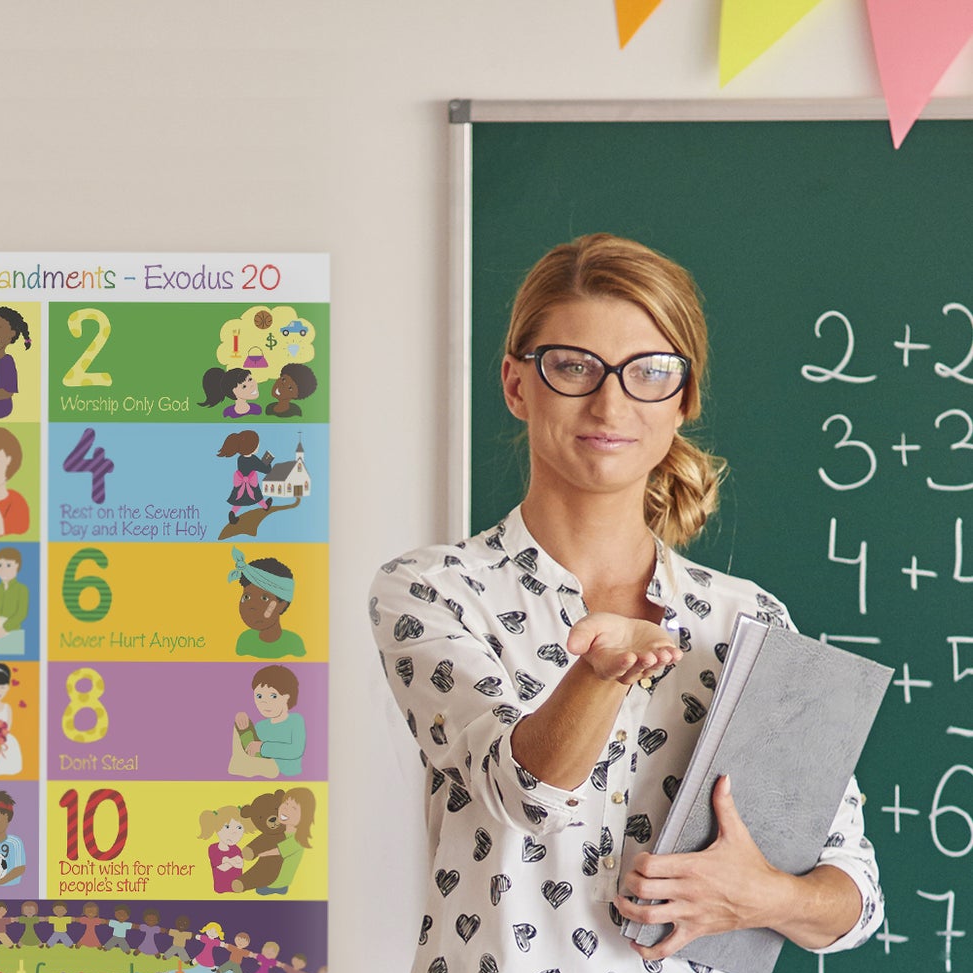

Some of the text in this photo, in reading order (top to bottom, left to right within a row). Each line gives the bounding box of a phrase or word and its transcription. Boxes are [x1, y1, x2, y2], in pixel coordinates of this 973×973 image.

[145, 264, 234, 290] Exodus
[242, 264, 280, 290] 20
[62, 308, 112, 387] 2
[60, 394, 190, 415] Worship Only God
[63, 427, 114, 504] 4
[60, 504, 200, 519] Rest on the Seventh
[60, 521, 207, 541] Day and Keep it Holy
[62, 547, 112, 623] 6
[60, 631, 206, 653] Never Hurt Anyone
[61, 667, 109, 744] 8
[59, 754, 139, 771] Don't Steal
[59, 789, 128, 861] 10
[59, 860, 195, 876] Don't wish for other
[59, 877, 149, 896] people's stuff
